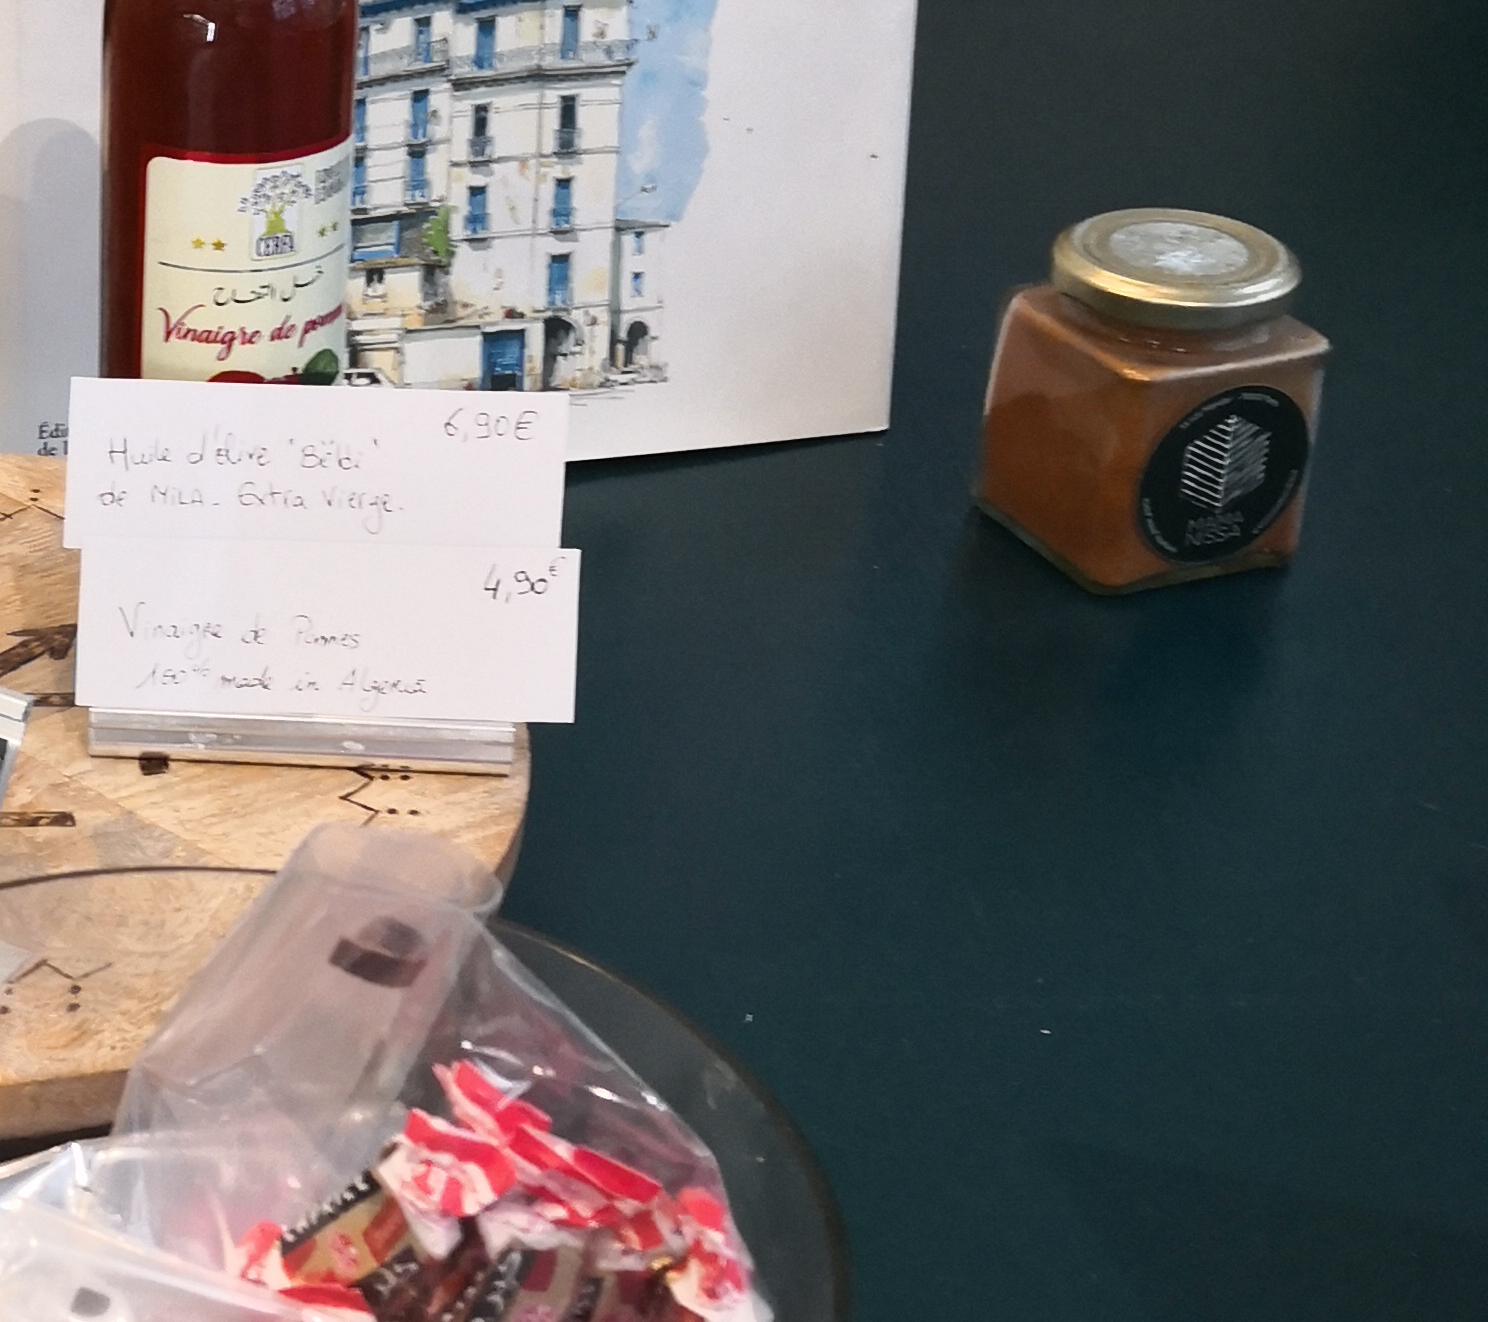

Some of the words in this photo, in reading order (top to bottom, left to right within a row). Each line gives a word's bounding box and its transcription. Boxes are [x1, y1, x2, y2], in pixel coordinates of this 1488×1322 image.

[158, 303, 263, 362] Vinaigre
[269, 314, 299, 343] de
[442, 409, 539, 444] 6,90€
